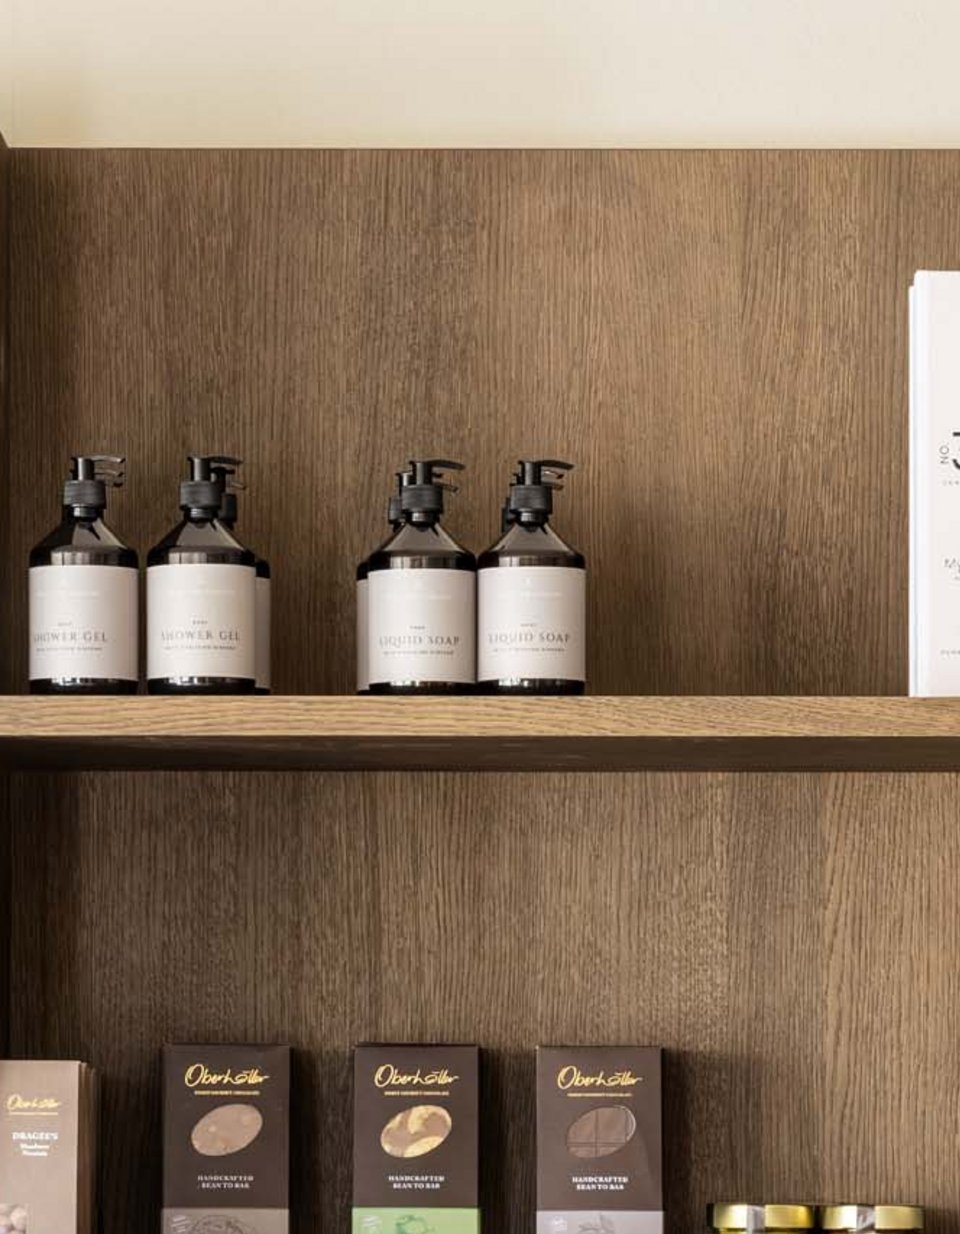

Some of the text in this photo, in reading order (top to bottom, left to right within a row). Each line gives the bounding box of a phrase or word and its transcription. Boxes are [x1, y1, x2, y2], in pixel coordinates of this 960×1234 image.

[83, 631, 108, 643] GEL
[161, 630, 240, 642] SHOWER GEL
[379, 635, 460, 648] LIQUID SOAP
[488, 632, 570, 645] LIQUID SOAP
